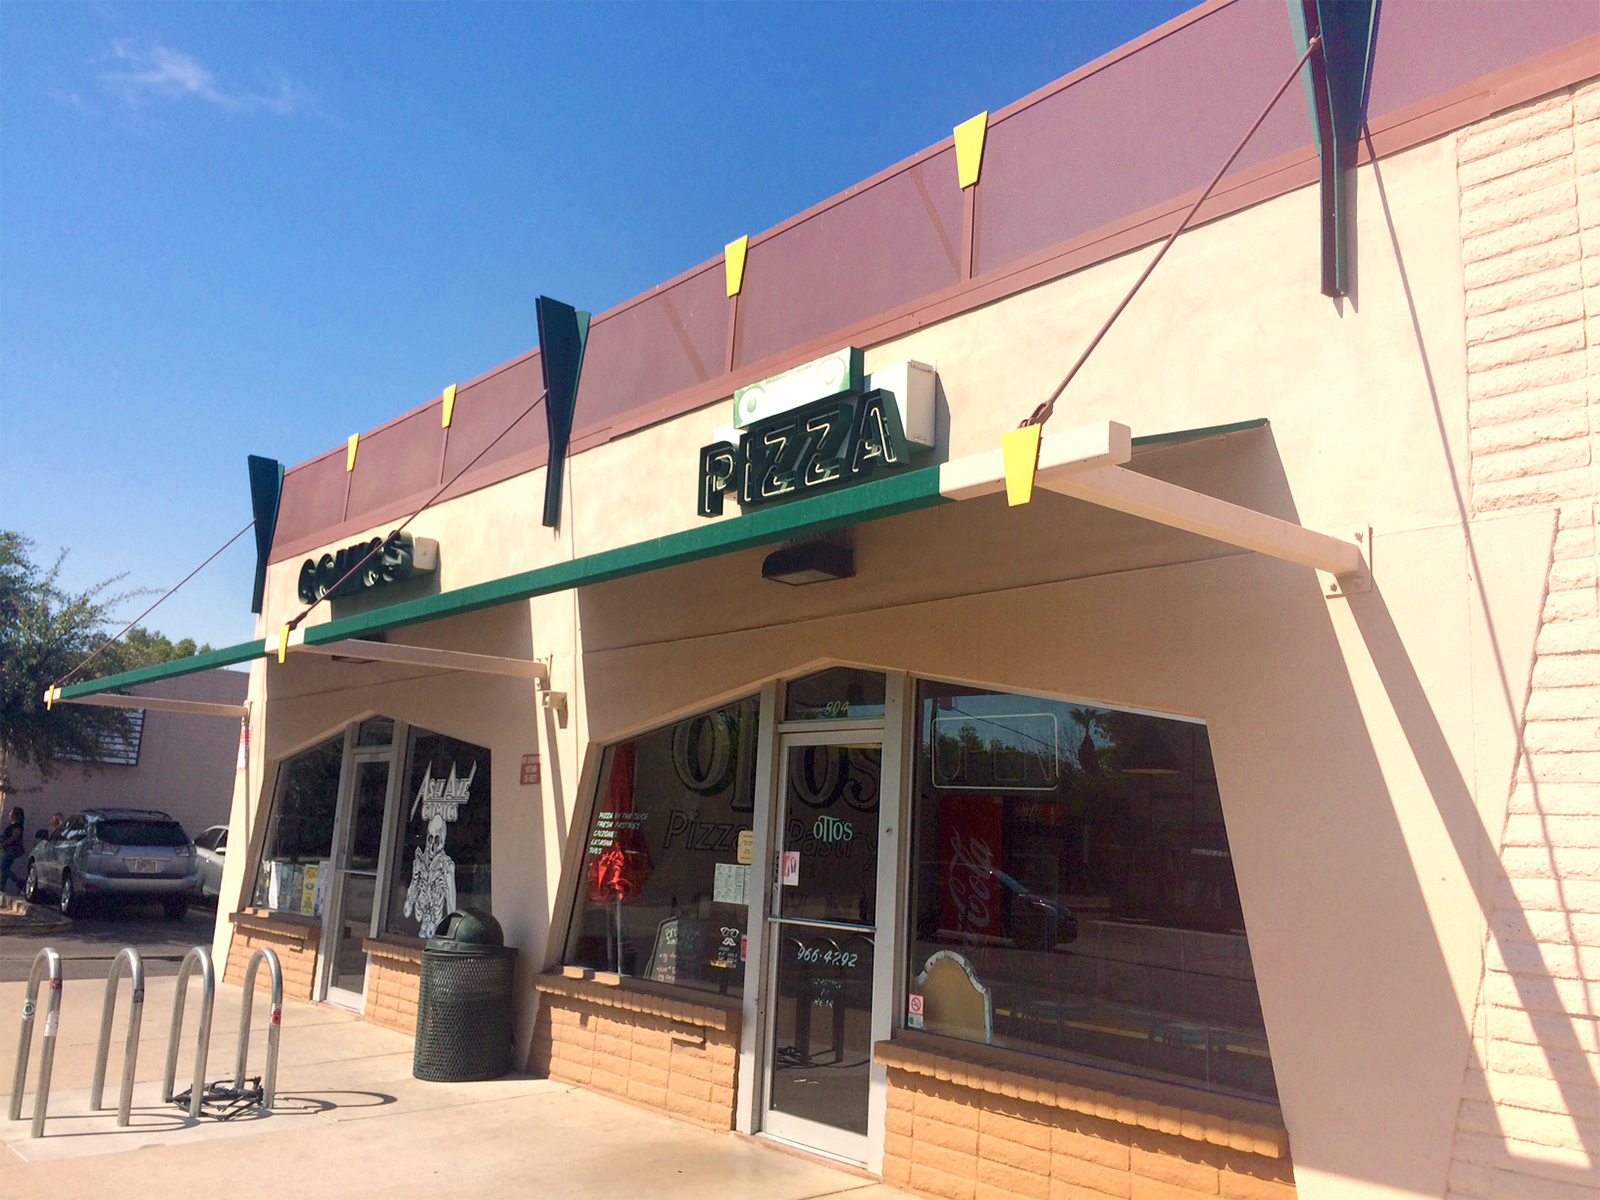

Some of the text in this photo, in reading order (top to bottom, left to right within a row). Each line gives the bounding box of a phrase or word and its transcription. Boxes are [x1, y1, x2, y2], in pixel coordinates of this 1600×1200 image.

[698, 388, 911, 518] PIZZA
[824, 700, 850, 715] 804
[410, 761, 446, 822] ASH
[422, 803, 459, 823] COMICS
[597, 820, 614, 828] FRESH
[591, 838, 613, 846] LASAGNA
[589, 847, 602, 855] SUBS
[797, 947, 858, 968] 966-4292
